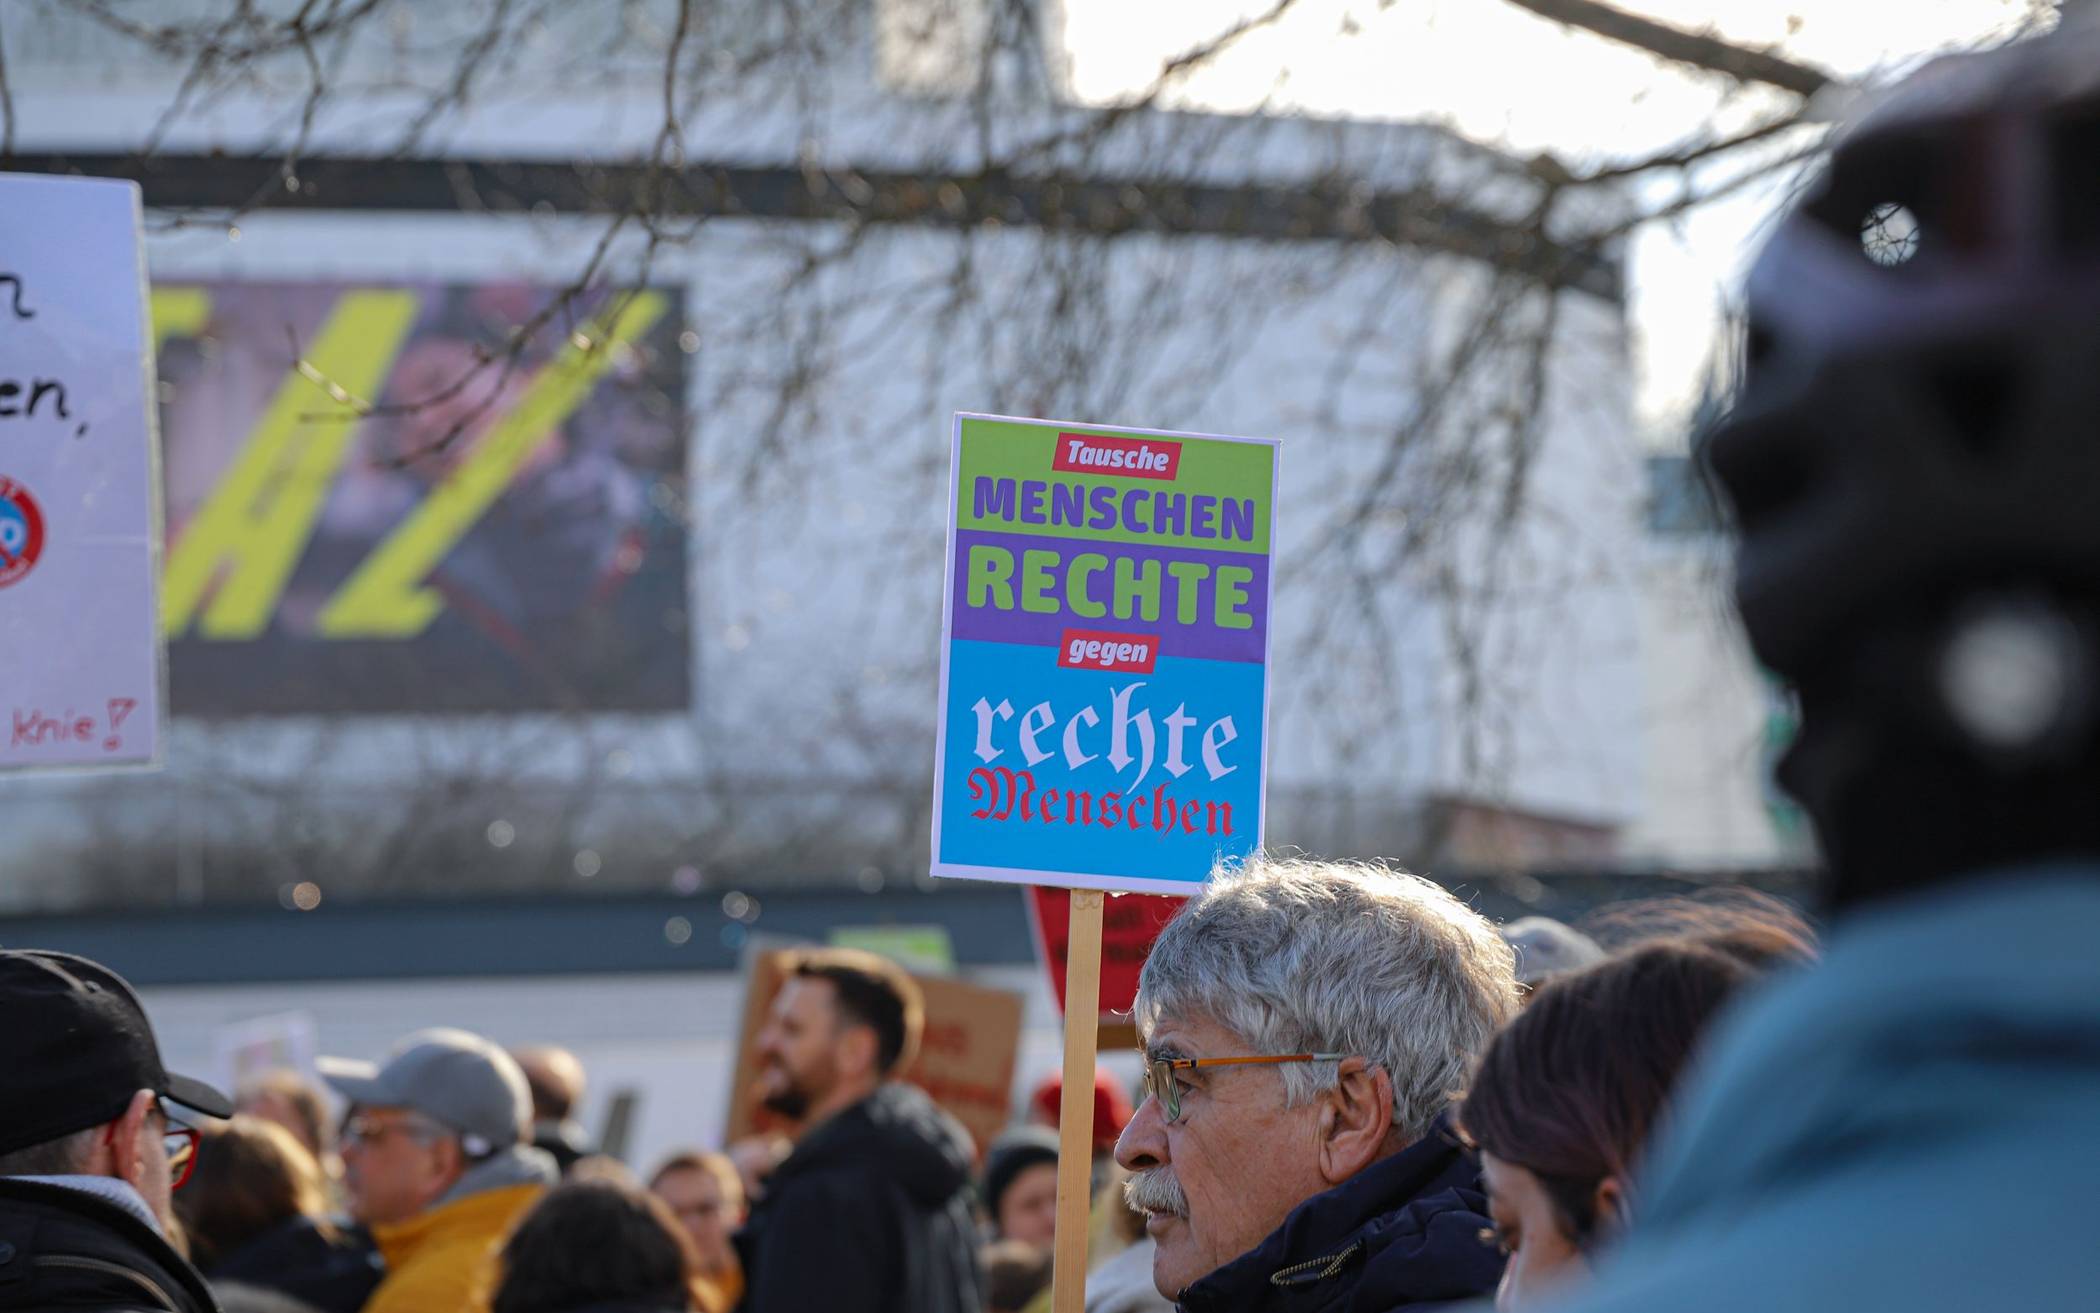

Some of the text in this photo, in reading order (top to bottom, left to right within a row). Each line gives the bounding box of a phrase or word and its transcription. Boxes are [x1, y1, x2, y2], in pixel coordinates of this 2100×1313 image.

[152, 287, 668, 640] AL
[1067, 440, 1169, 472] Tausche
[973, 476, 1255, 542] MENSCHEN
[966, 544, 1254, 630] RECHTE
[1068, 636, 1148, 666] gegen
[971, 681, 1238, 795] rechte
[967, 766, 1234, 842] Menschen
